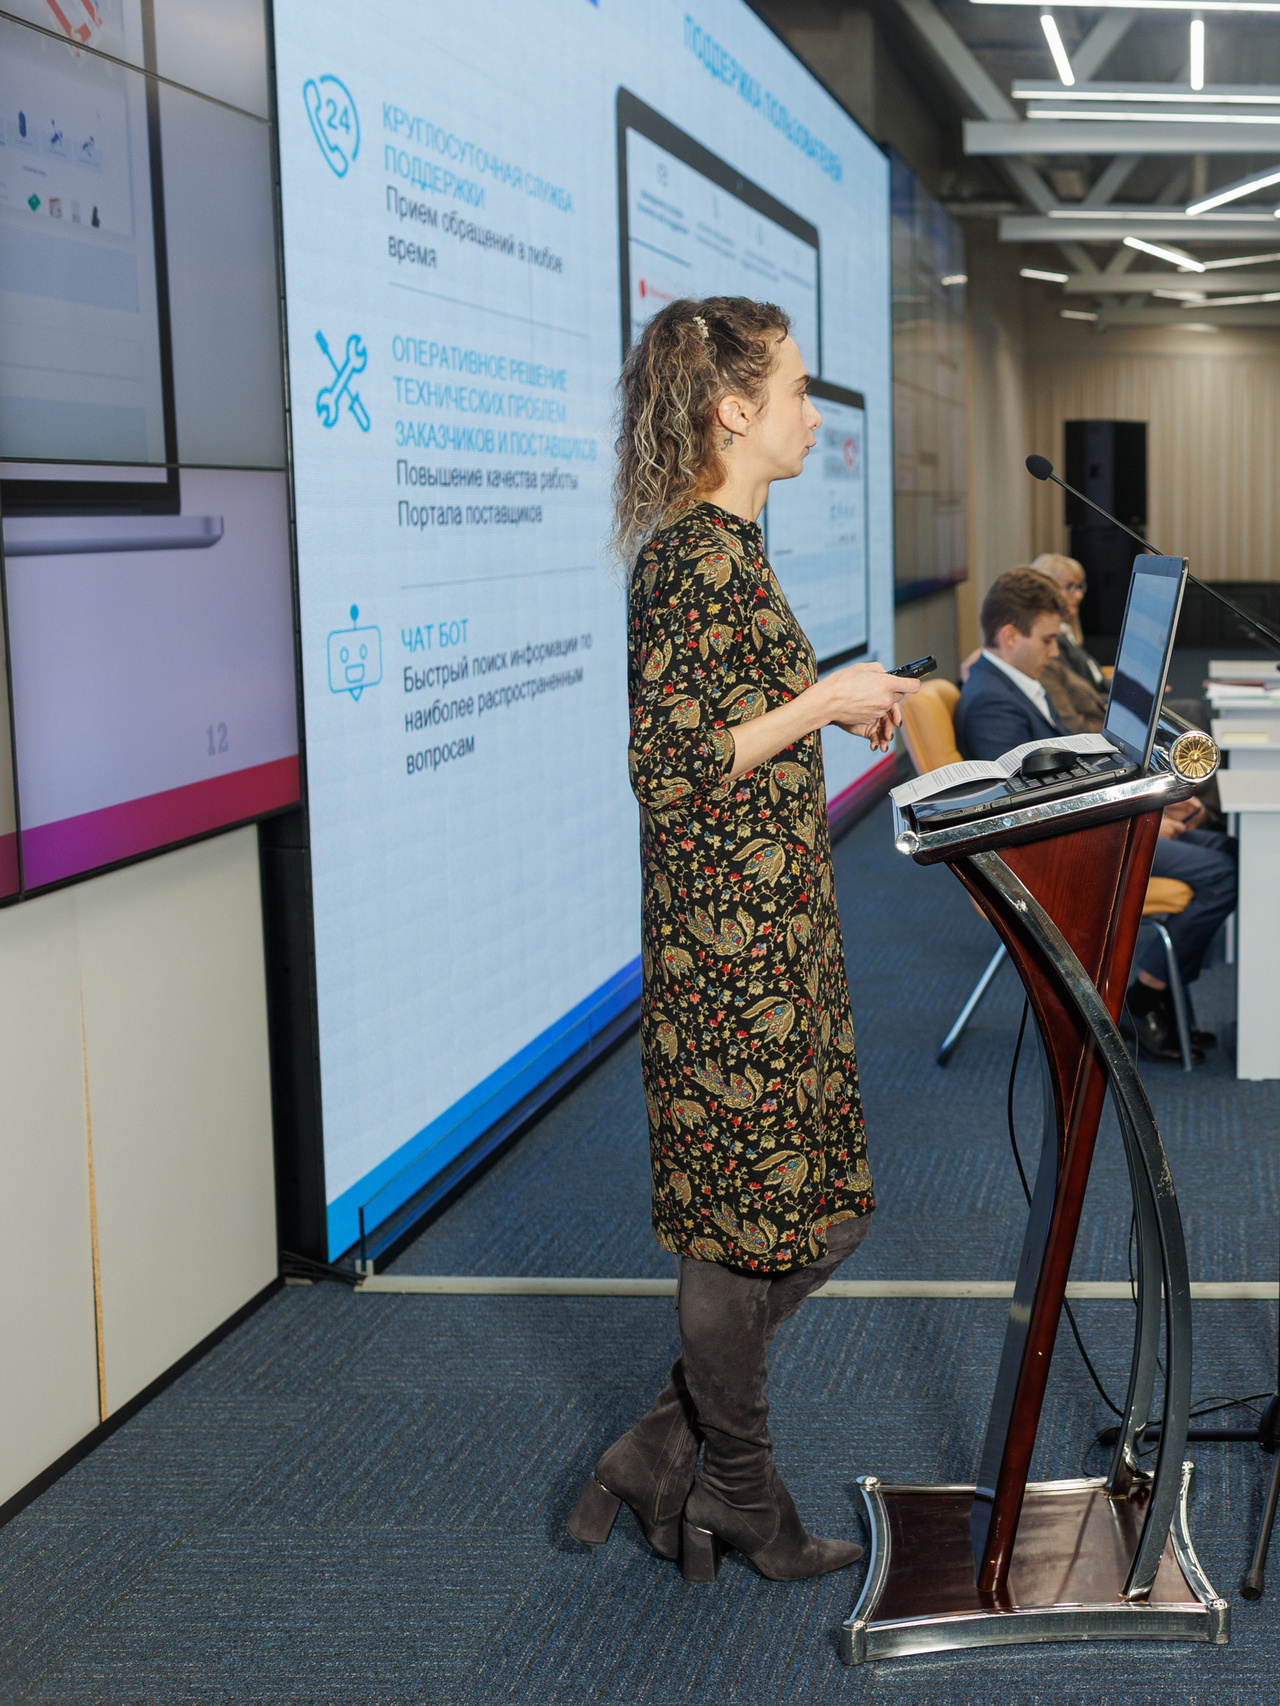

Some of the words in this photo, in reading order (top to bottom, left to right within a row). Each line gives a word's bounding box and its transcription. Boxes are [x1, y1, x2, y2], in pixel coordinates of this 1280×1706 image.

[326, 97, 350, 135] 24
[382, 101, 522, 189] КРУГЛОСУТОЧНАЯ
[525, 172, 575, 213] СЛУЖБА
[384, 144, 486, 210] ПОДДЕРЖКИ
[386, 184, 438, 228] Прием
[442, 209, 515, 256] обращений
[388, 235, 437, 269] время
[392, 335, 506, 381] ОПЕРАТИВНОЕ
[510, 358, 568, 393] РЕШЕНИЕ
[393, 376, 505, 416] ТЕХНИЧЕСКИХ
[508, 393, 567, 424] ПРОБЛЕМ
[395, 420, 495, 455] ЗАКАЗЧИКОВ
[498, 430, 508, 454] И
[511, 431, 598, 463] ПОСТАВЩИКОВ
[397, 459, 482, 488] Повышение
[486, 467, 537, 490] качества
[540, 465, 578, 493] работы
[398, 500, 462, 531] Портала
[465, 504, 542, 527] поставщиков
[401, 624, 434, 653] ЧАТ
[439, 619, 469, 648] БОТ
[403, 659, 469, 693] Быстрый
[472, 653, 507, 678] поиск
[510, 638, 578, 667] информации
[404, 699, 474, 733] наиболее
[477, 667, 584, 716] распространенным
[206, 721, 229, 756] 12
[406, 734, 475, 775] вопросам
